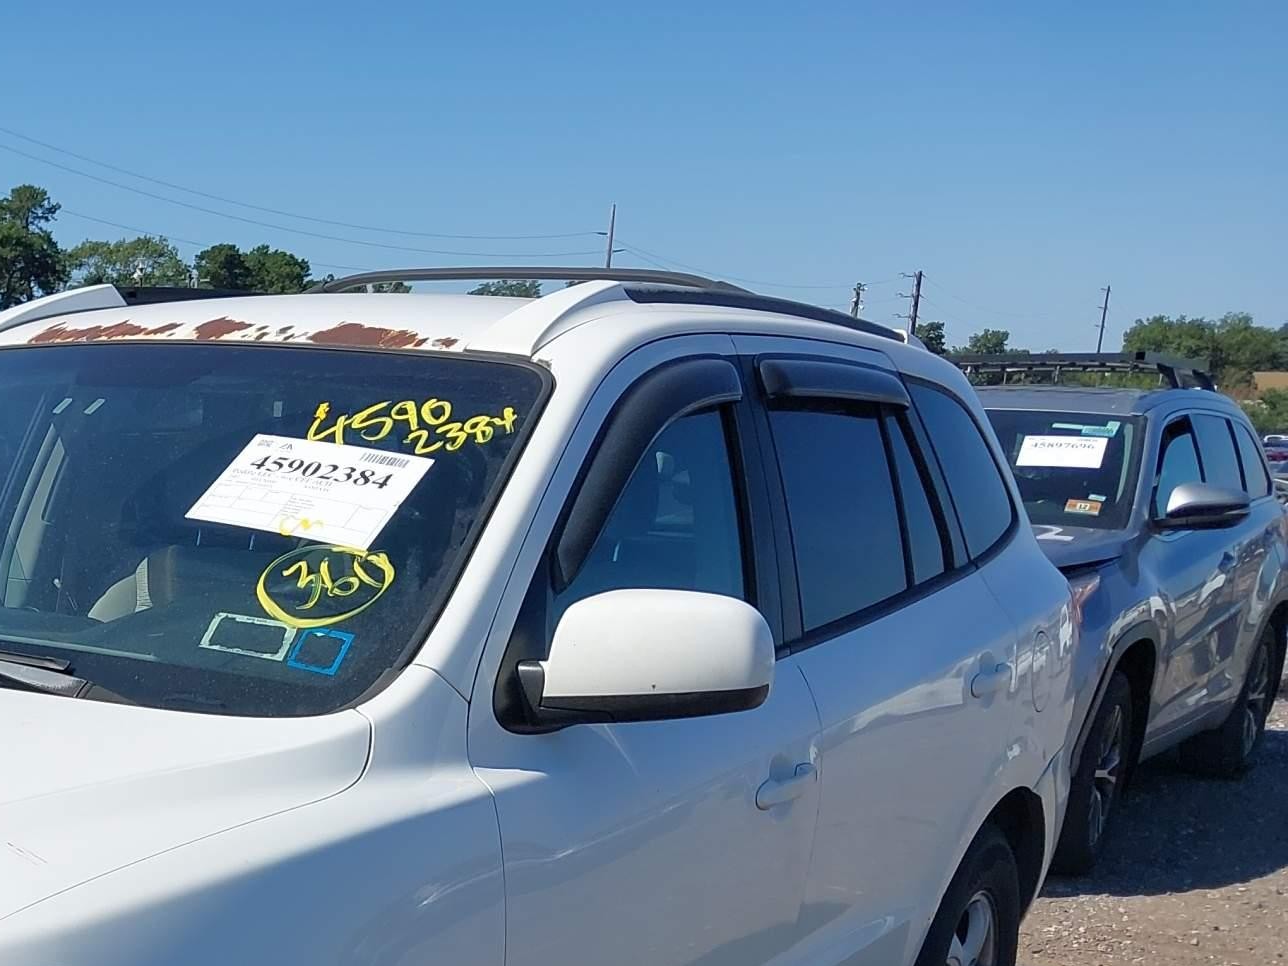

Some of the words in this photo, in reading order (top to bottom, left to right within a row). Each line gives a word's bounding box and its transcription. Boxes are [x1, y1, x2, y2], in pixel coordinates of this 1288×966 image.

[307, 398, 453, 445] 4590
[403, 407, 518, 455] 2384
[249, 453, 395, 490] 45902384
